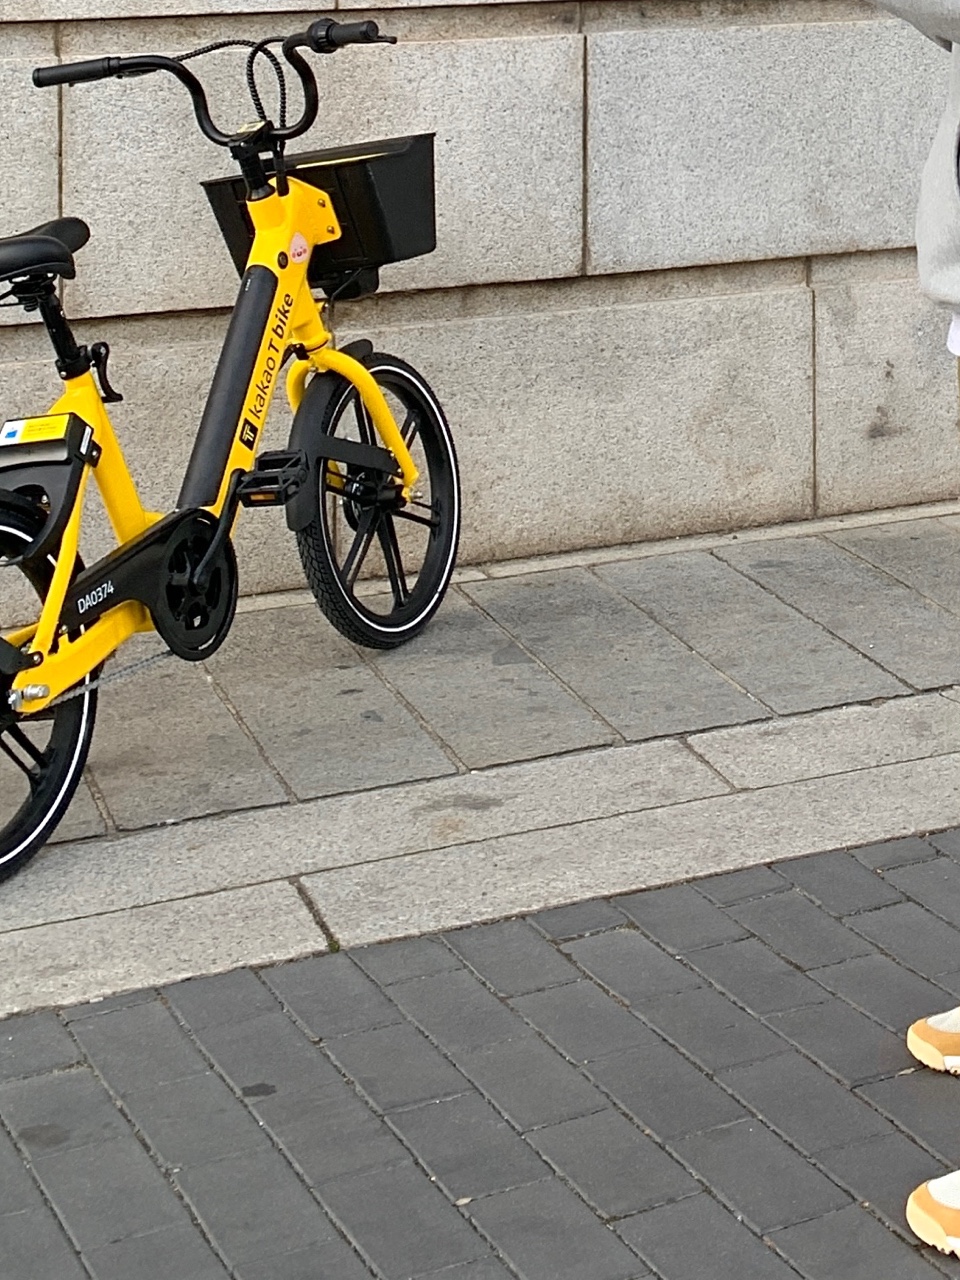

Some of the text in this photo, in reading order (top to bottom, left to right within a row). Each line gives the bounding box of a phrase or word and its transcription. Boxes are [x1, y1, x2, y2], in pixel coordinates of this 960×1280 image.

[272, 293, 294, 340] bike
[267, 338, 280, 354] T
[248, 356, 276, 420] kakao
[77, 580, 115, 614] DA0374
